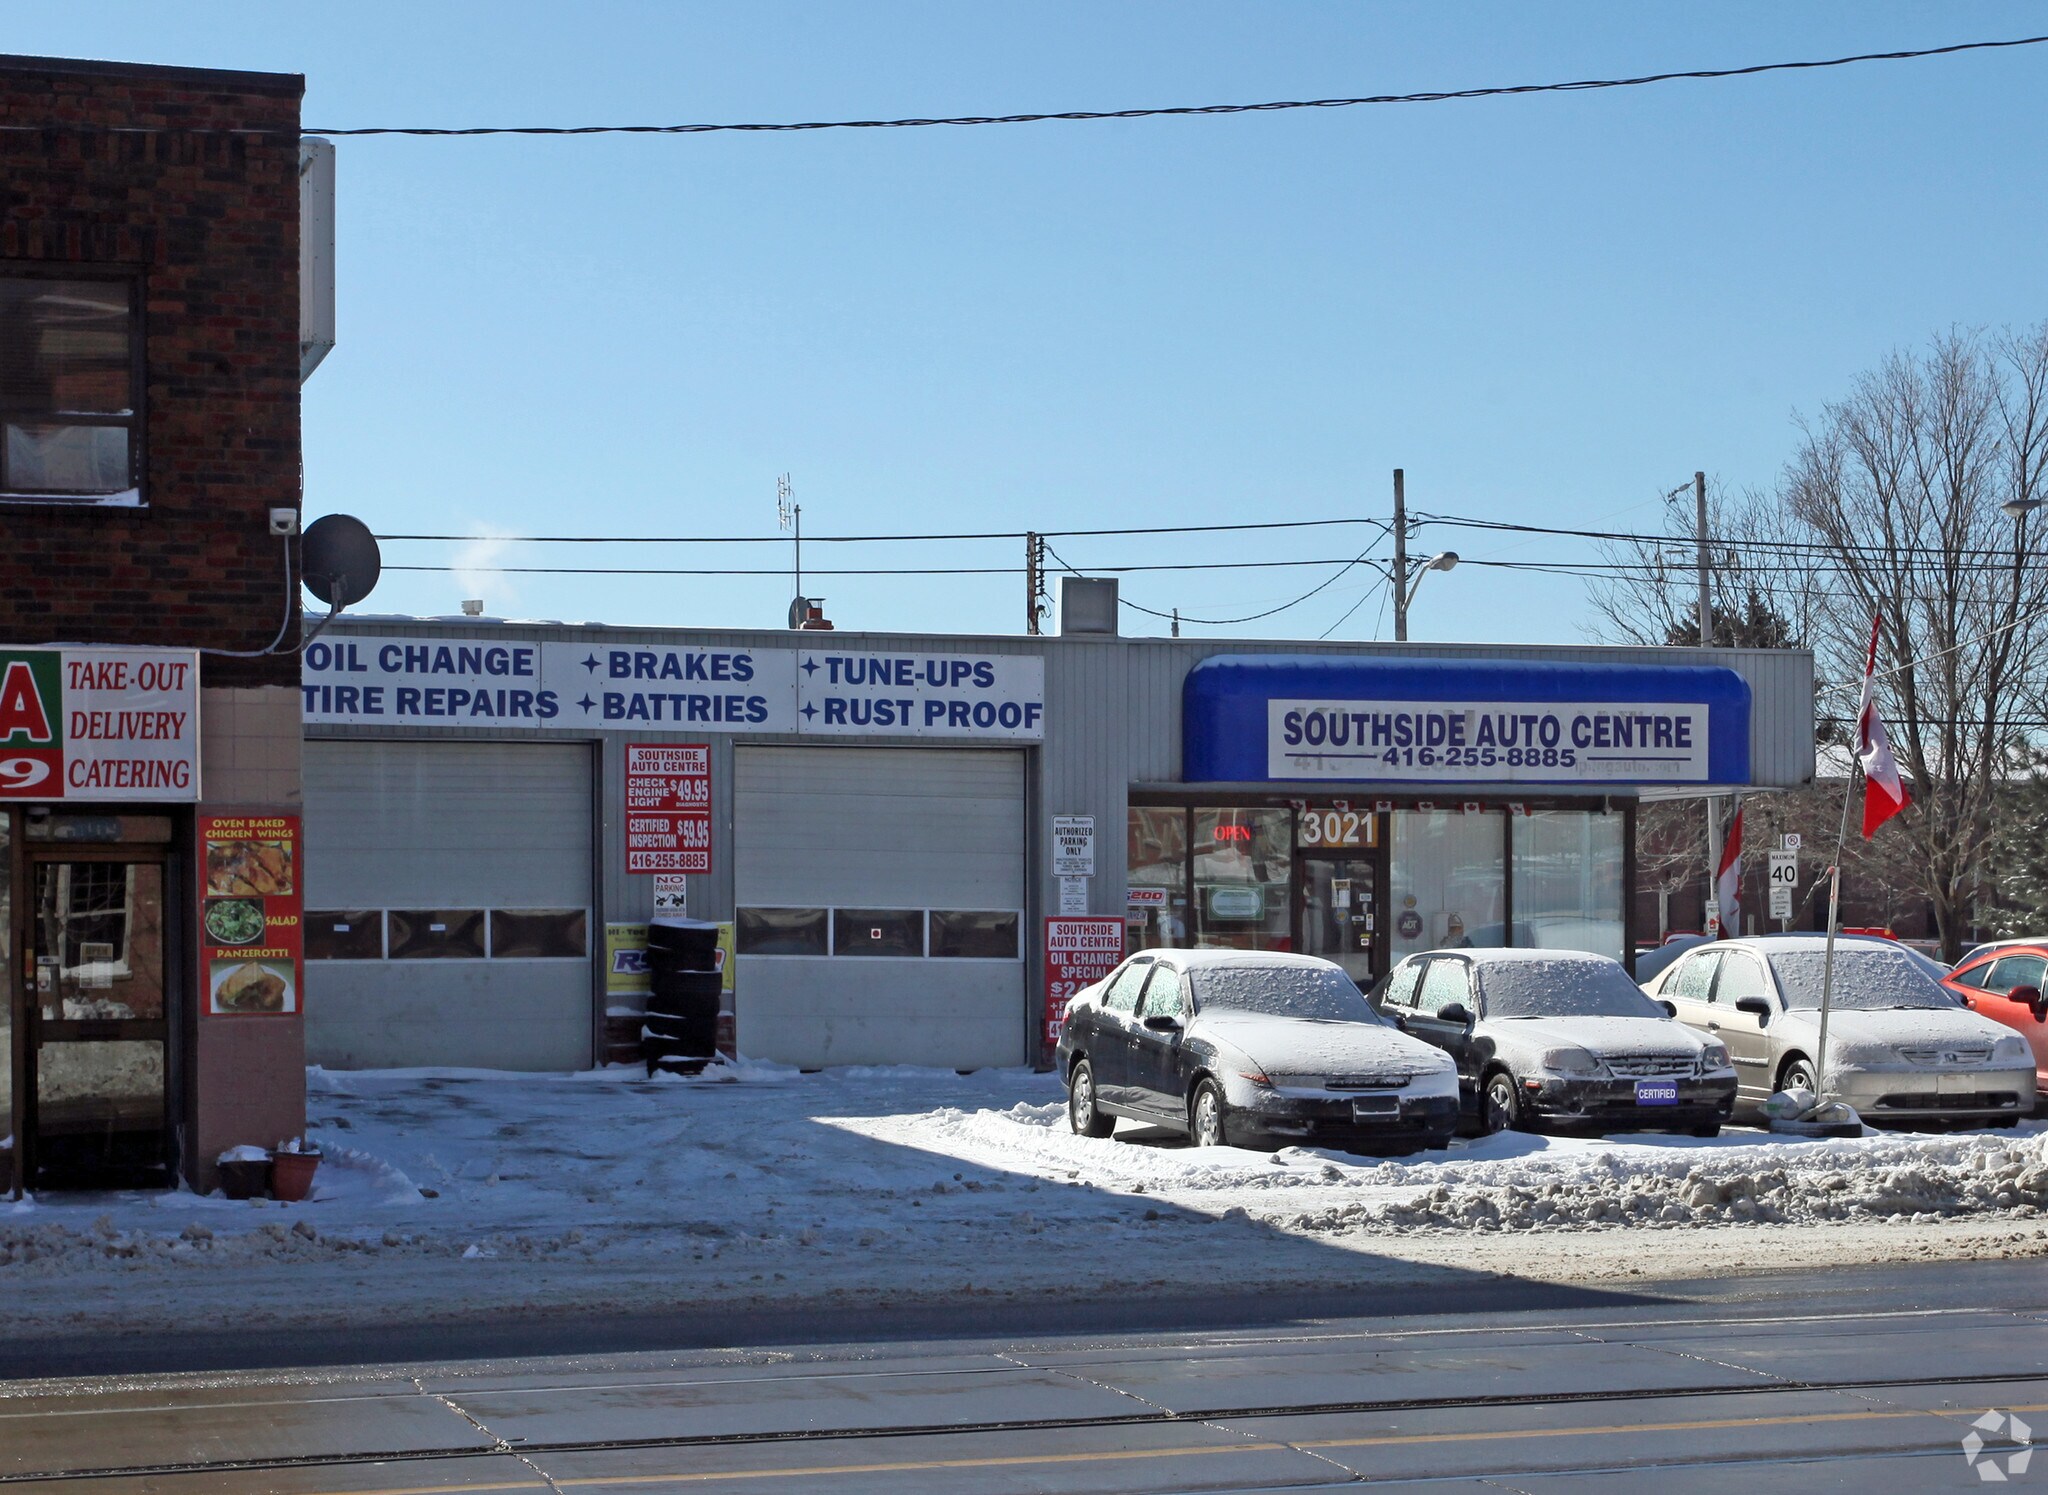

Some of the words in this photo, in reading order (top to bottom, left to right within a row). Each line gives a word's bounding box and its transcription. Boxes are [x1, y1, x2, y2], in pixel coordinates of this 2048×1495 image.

[306, 643, 368, 672] OIL
[378, 645, 535, 677] CHANGE
[609, 651, 754, 682] BRAKES
[825, 656, 996, 689] TUNE-UPS
[0, 662, 52, 742] A
[302, 685, 384, 714] TIRE
[396, 687, 559, 719] REPAIRS
[603, 692, 769, 723] BATTRIES
[824, 697, 914, 728] RUST
[925, 701, 1044, 730] PROOF
[70, 711, 187, 740] DELIVERY
[1284, 711, 1466, 748] SOUTHSIDE
[1476, 713, 1562, 749] AUTO
[1570, 715, 1692, 750] CENTRE
[638, 749, 700, 762] SOUTHSIDE
[1381, 748, 1577, 768] 416-255-8885
[0, 758, 51, 789] 9
[69, 759, 190, 788] CATERING
[631, 761, 662, 773] AUTO
[664, 762, 707, 773] CENTRE
[628, 777, 667, 789] CHECK
[669, 778, 709, 802] $49.95
[628, 787, 671, 798] ENGINE
[628, 797, 661, 807] LIGHT
[212, 819, 246, 829] OVEN
[248, 819, 286, 829] BAKED
[629, 819, 671, 833] CERTIFIED
[1055, 826, 1093, 836] AUTHORIZED
[1303, 812, 1374, 843] 3021
[205, 829, 253, 839] CHICKEN
[257, 829, 294, 839] WINGS
[677, 820, 710, 849] $59.95
[1214, 825, 1251, 842] OPEN
[629, 834, 677, 848] INSPECTION
[1060, 836, 1088, 846] PARKING
[1065, 846, 1082, 856] ONLY
[631, 853, 707, 869] 416-255-8885
[656, 876, 684, 884] NO
[1772, 865, 1795, 882] 40
[655, 884, 685, 892] PARKING
[265, 915, 298, 926] SALAD
[1402, 920, 1418, 930] ADT
[1056, 924, 1114, 936] SOUTHSIDE
[1050, 936, 1077, 948] AUTO
[1080, 936, 1120, 948] CENTRE
[216, 948, 289, 958] PANZEROTTI
[1050, 952, 1070, 966] OIL
[1072, 953, 1120, 966] CHANGE
[1638, 1089, 1676, 1099] CERTIFIED
